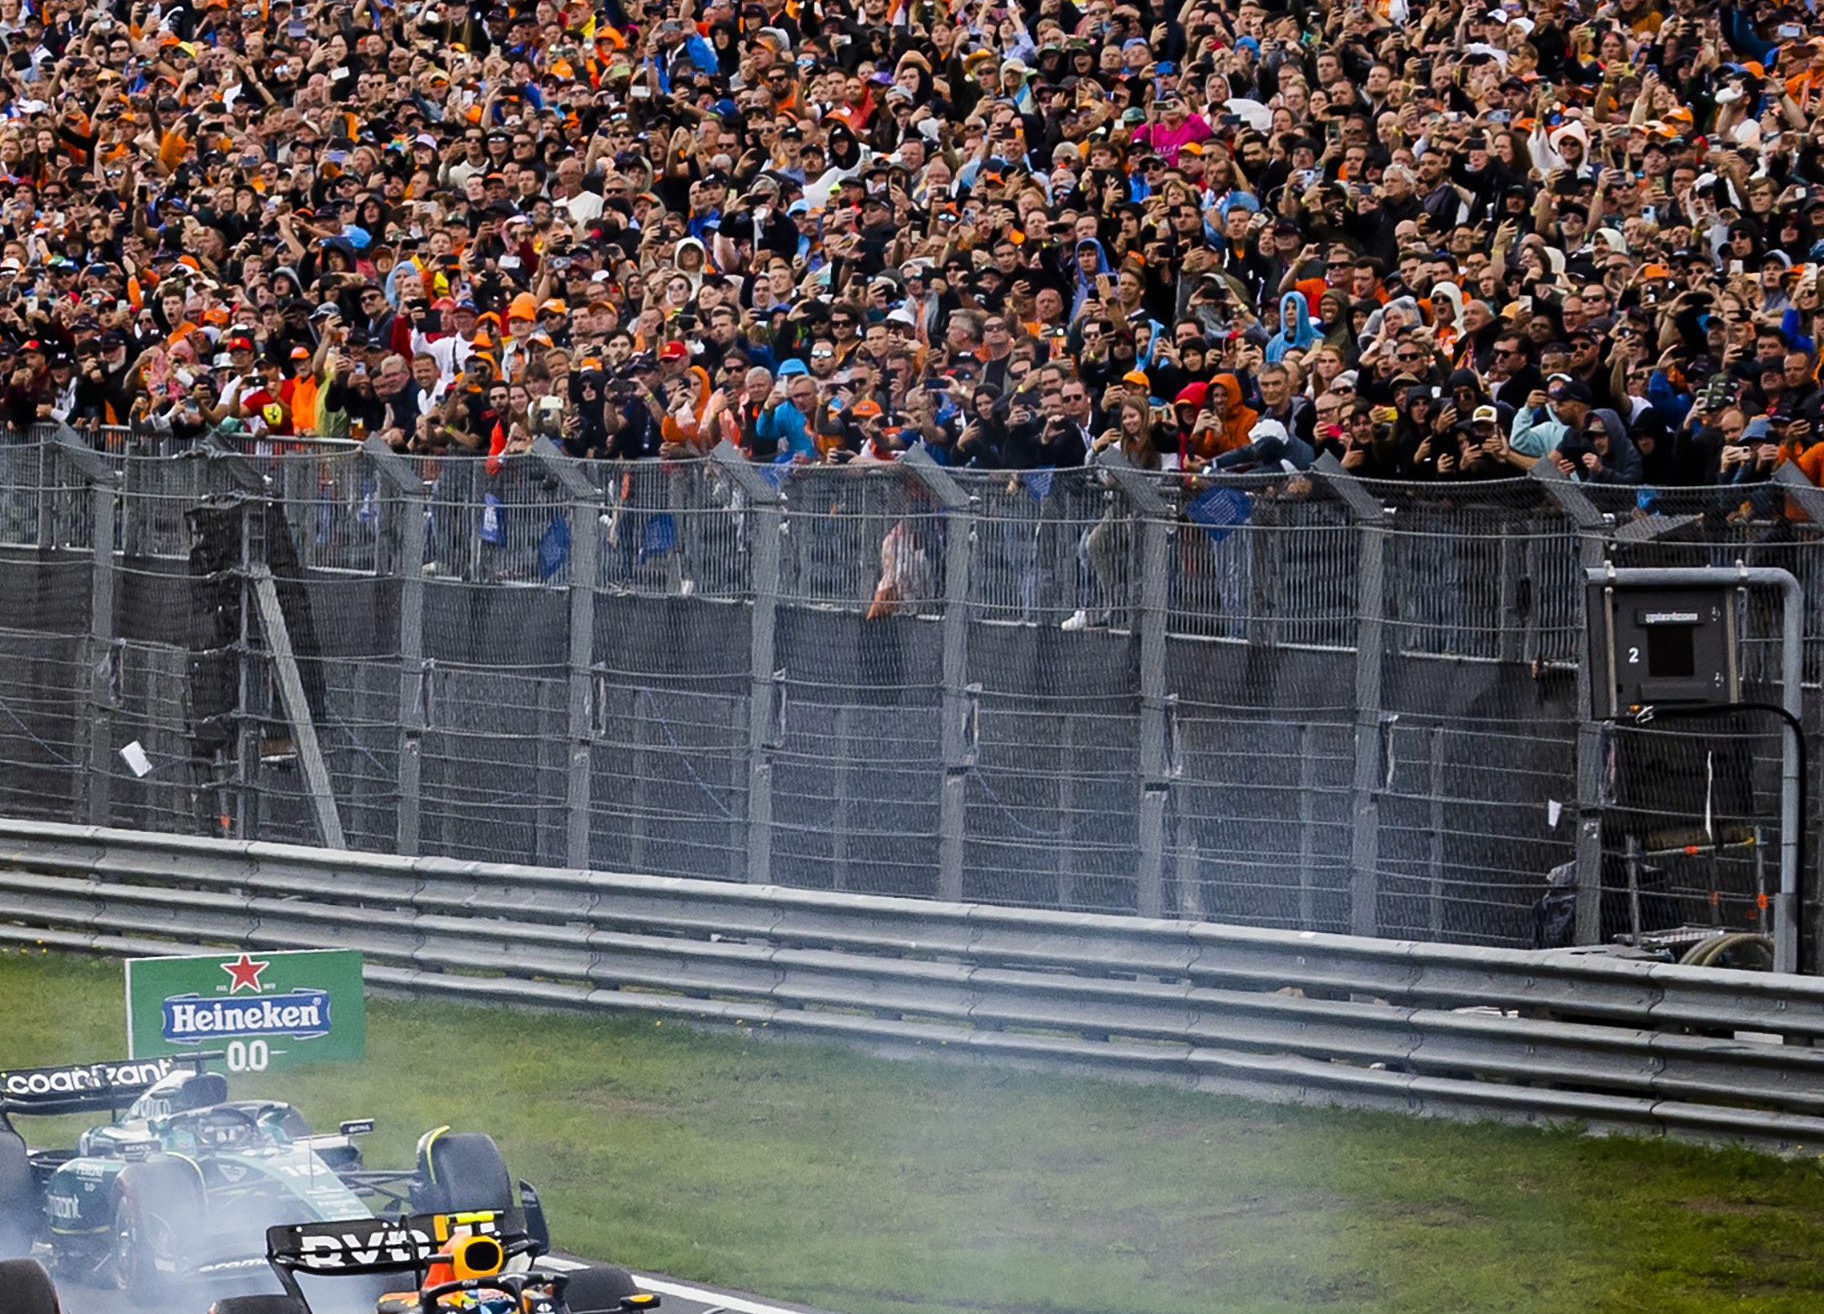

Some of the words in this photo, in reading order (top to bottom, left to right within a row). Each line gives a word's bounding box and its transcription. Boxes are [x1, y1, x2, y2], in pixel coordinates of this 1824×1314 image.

[1628, 647, 1639, 663] 2
[172, 1001, 321, 1033] Heineken
[227, 1040, 269, 1071] 0.0
